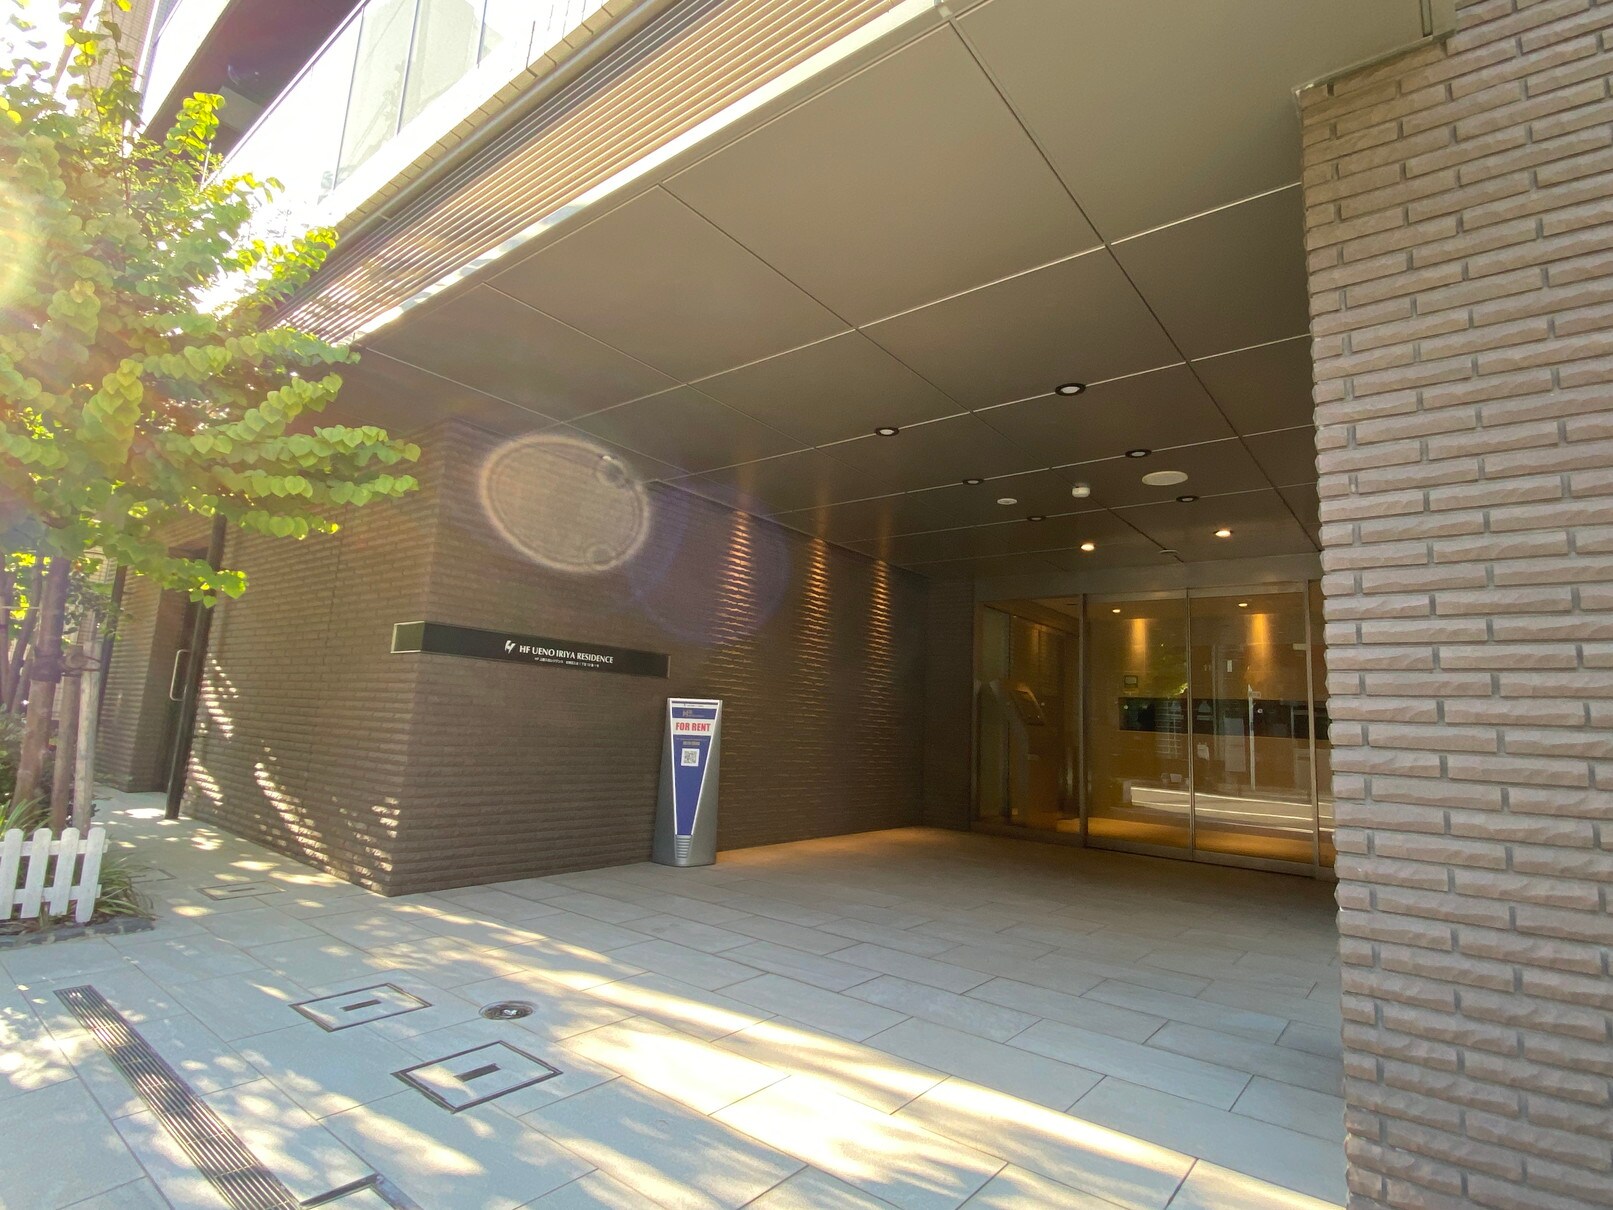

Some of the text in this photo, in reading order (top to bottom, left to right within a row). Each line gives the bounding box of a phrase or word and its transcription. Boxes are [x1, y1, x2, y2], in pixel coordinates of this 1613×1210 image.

[519, 645, 531, 654] HF
[532, 646, 555, 657] UENO
[556, 649, 575, 660] IRIYA
[577, 652, 614, 664] RESIDENCE
[675, 722, 711, 732] FOR RENT
